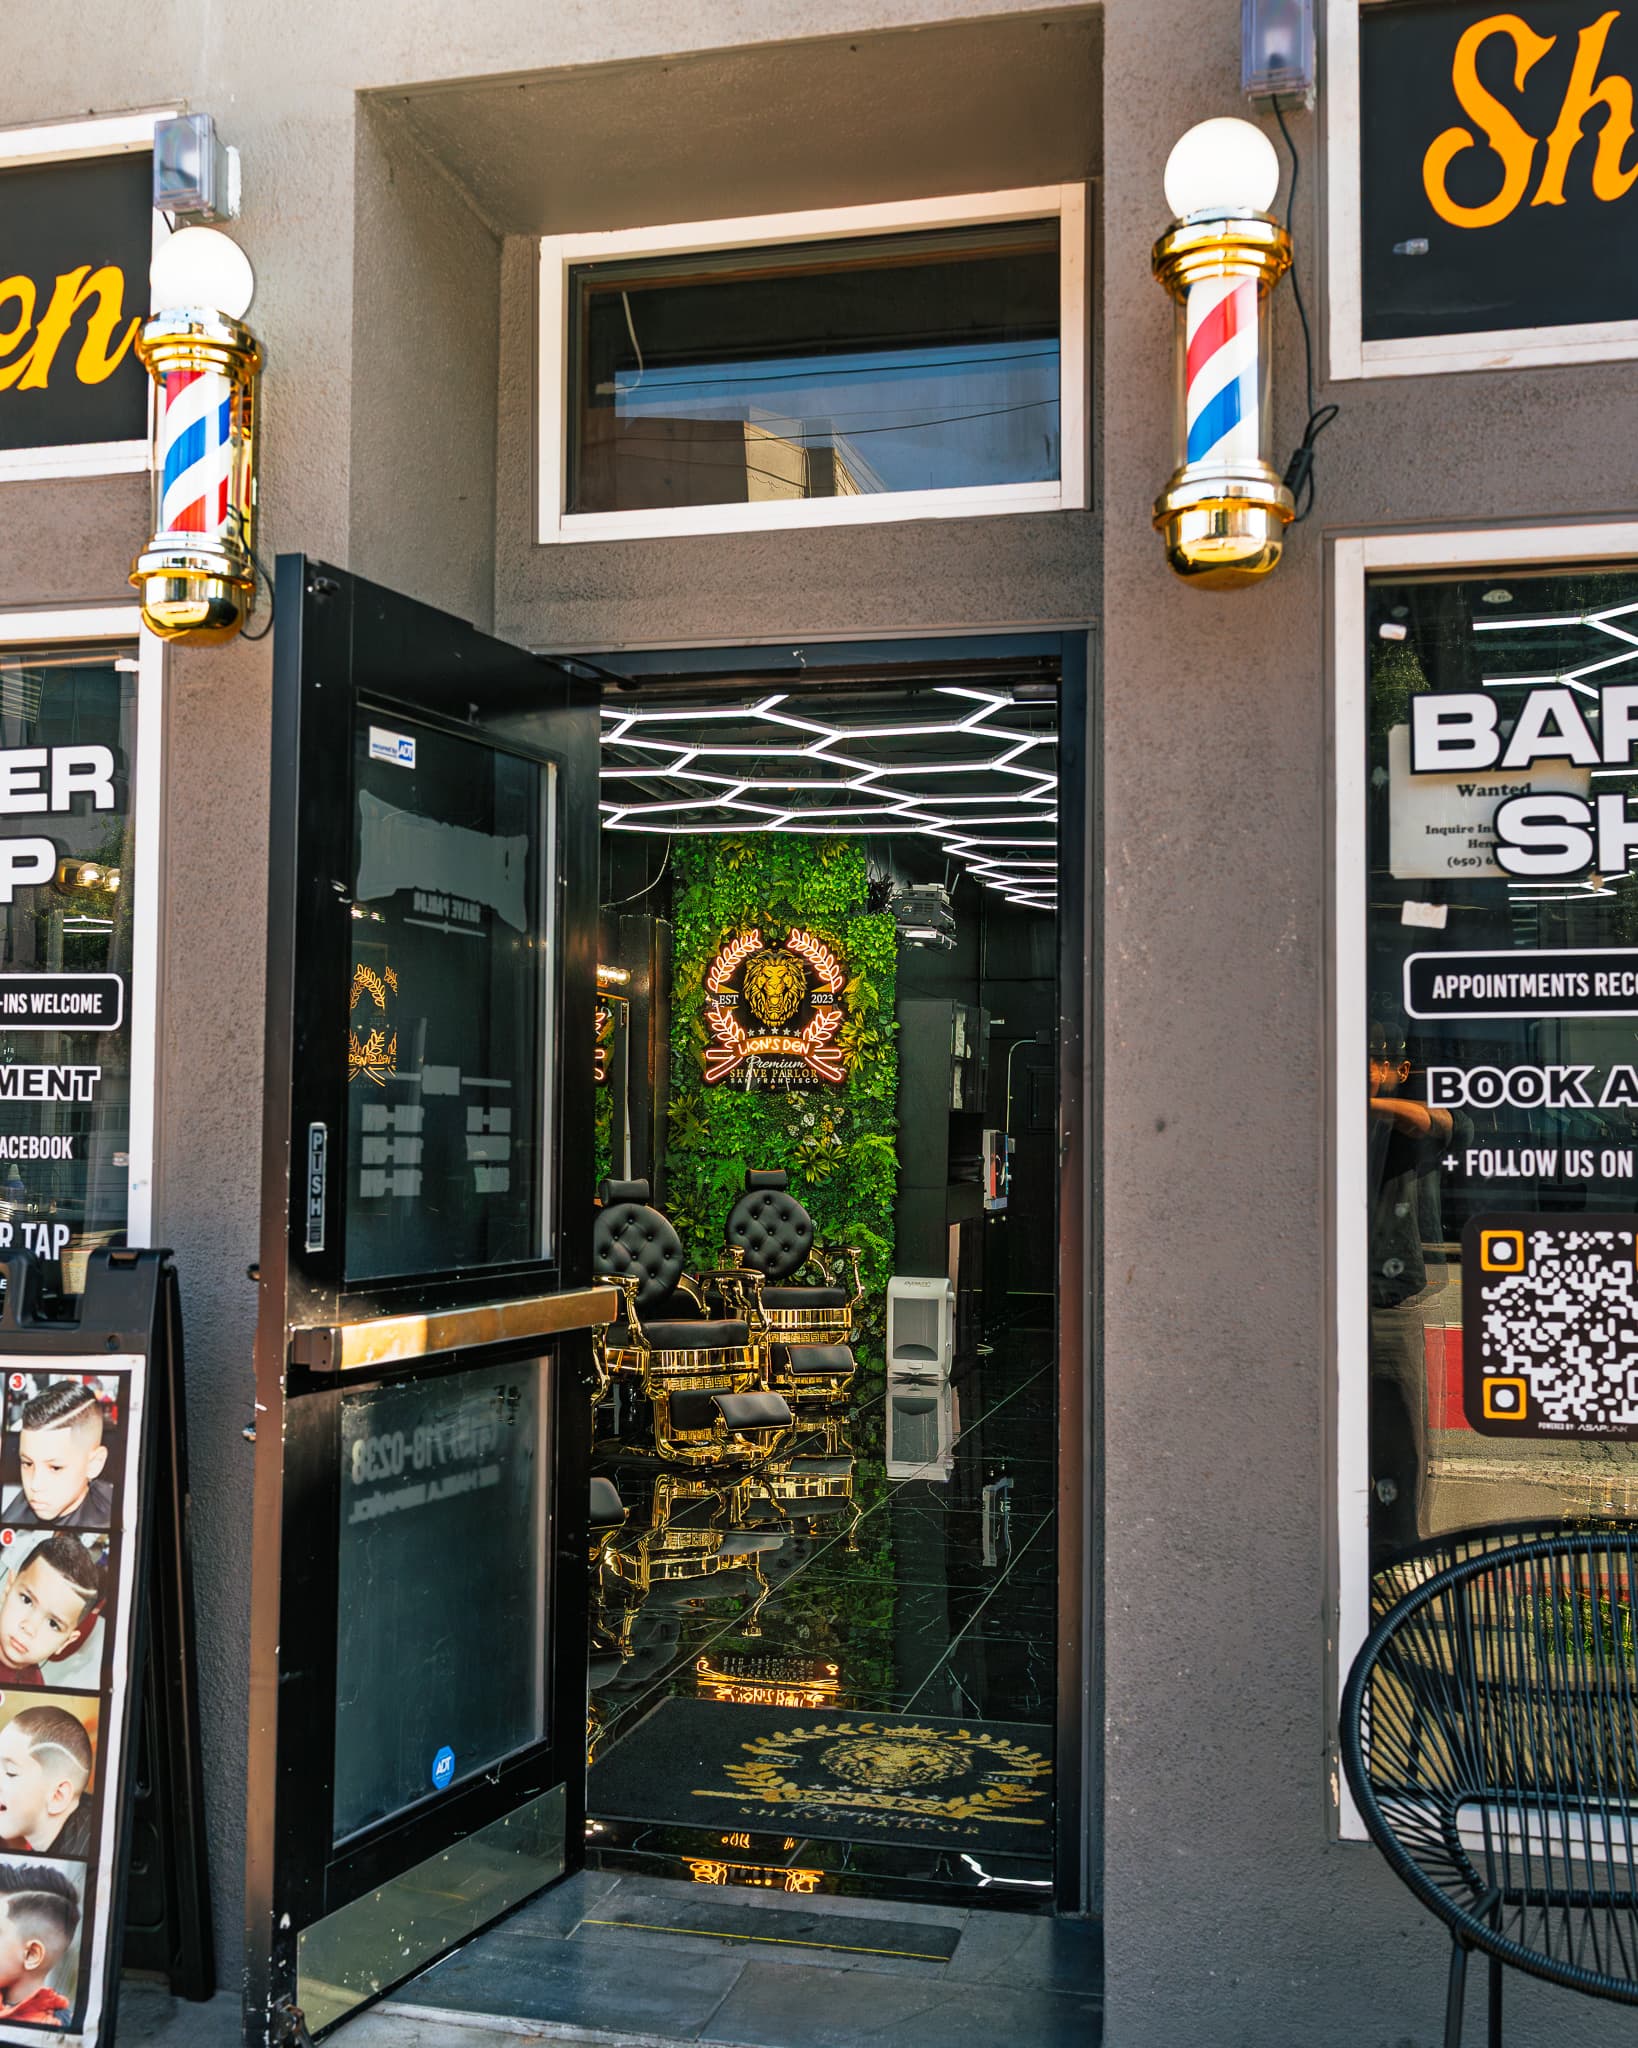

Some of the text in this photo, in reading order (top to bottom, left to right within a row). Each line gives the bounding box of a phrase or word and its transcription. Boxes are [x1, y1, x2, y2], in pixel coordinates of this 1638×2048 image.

[1456, 782, 1532, 798] Wanted
[1425, 824, 1474, 836] Inquire
[1447, 856, 1482, 867] (650)
[1432, 971, 1638, 999] APPOINTMENTS REC
[31, 993, 103, 1014] WELCOME
[718, 994, 739, 1005] EST
[811, 994, 834, 1004] 2023
[738, 1038, 810, 1055] LION'S DEN
[745, 1054, 806, 1069] Premium
[730, 1068, 818, 1078] SHAVE PARLOR
[1427, 1065, 1638, 1109] BOOK A
[1466, 1149, 1557, 1177] FOLLOW
[1565, 1149, 1594, 1177] US
[1601, 1149, 1633, 1178] ON
[21, 1222, 70, 1261] TAP
[11, 1375, 23, 1389] 3
[2, 1530, 13, 1545] 6
[435, 1755, 453, 1777] ADT
